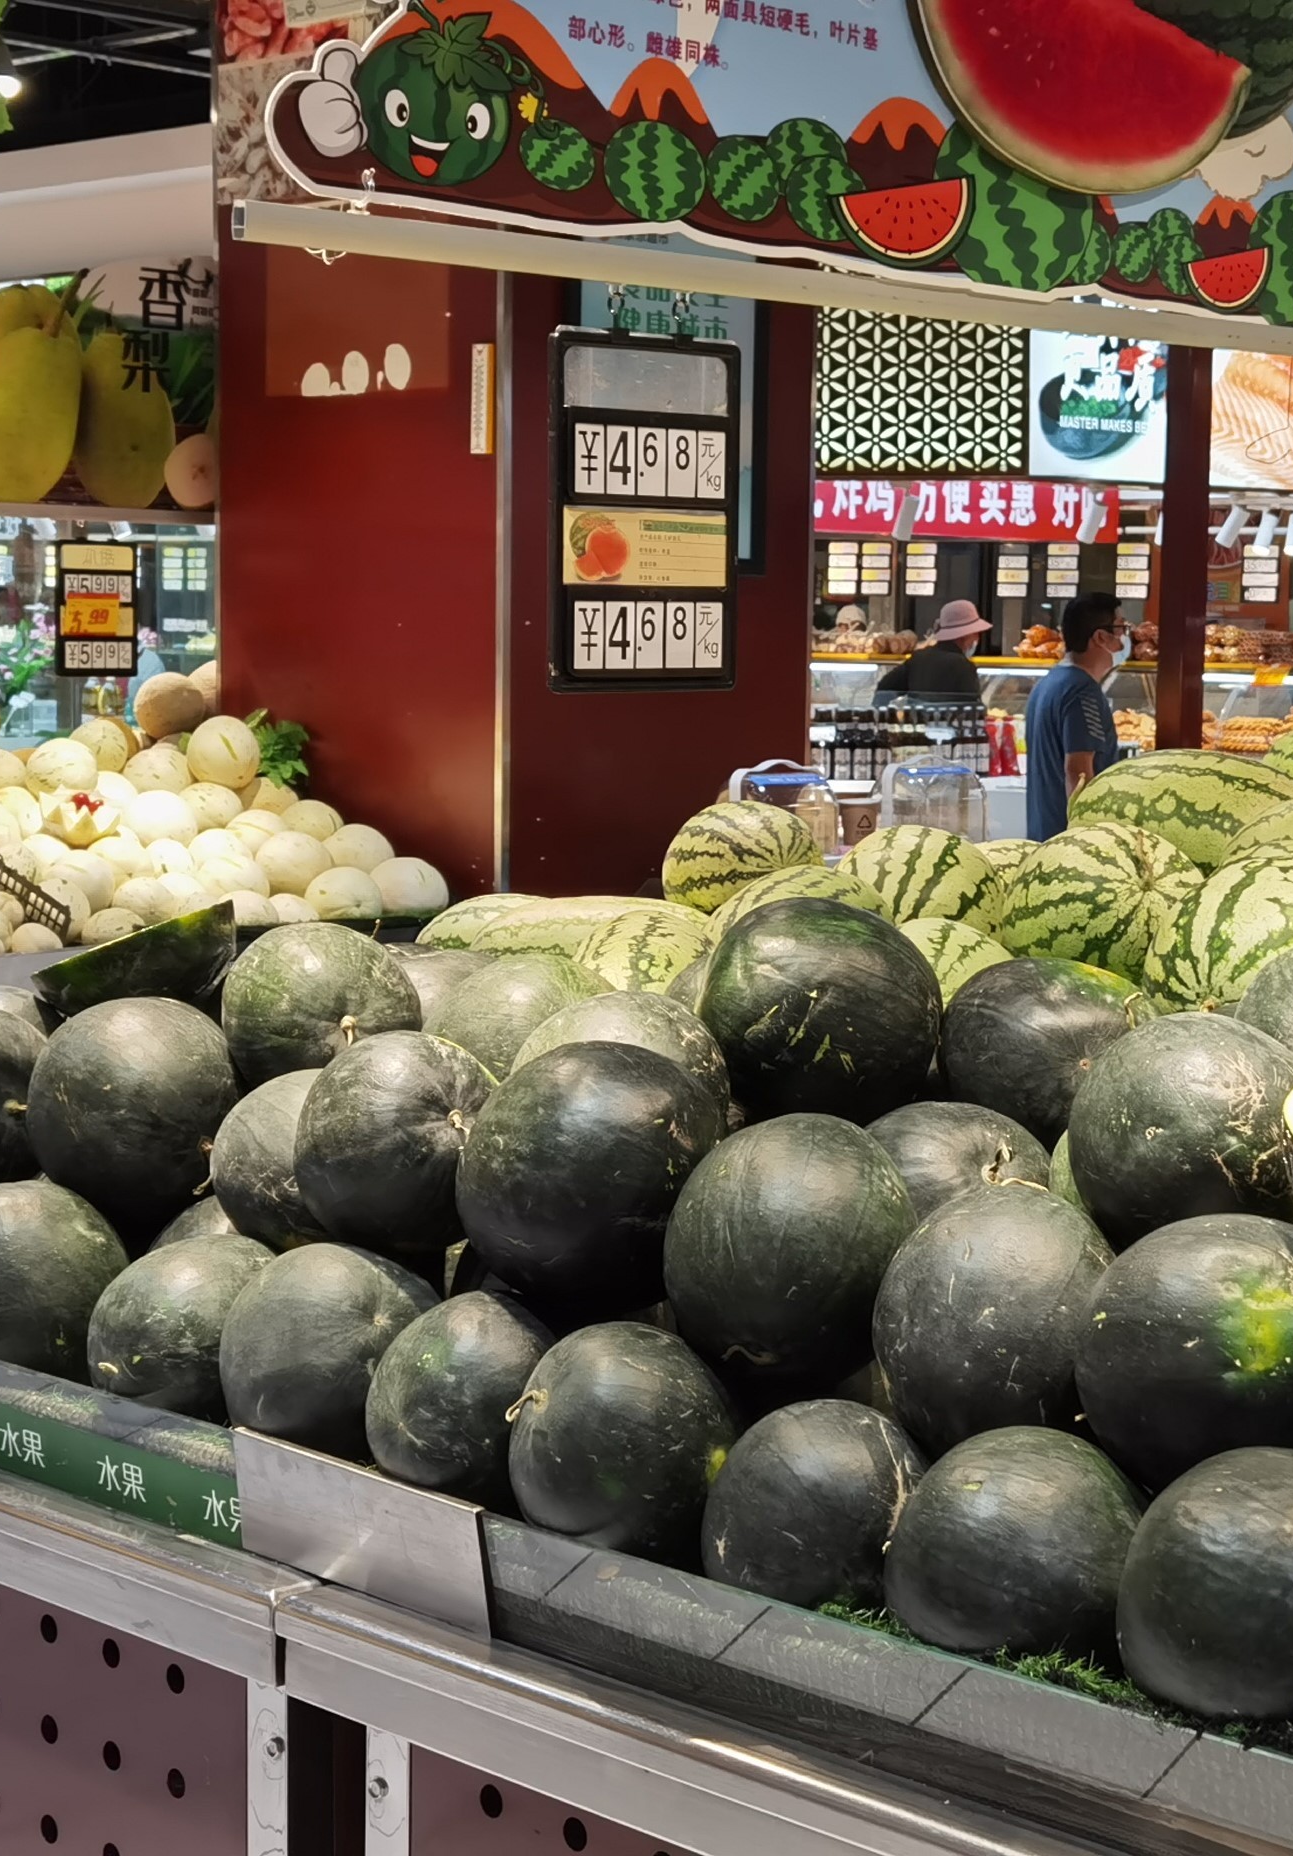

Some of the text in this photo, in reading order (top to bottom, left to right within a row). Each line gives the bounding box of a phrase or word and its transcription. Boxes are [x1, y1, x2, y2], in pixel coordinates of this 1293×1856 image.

[121, 265, 187, 396] 香梨
[1059, 415, 1099, 430] MASTER
[1100, 418, 1134, 433] MAKES
[96, 1454, 147, 1504] 水果
